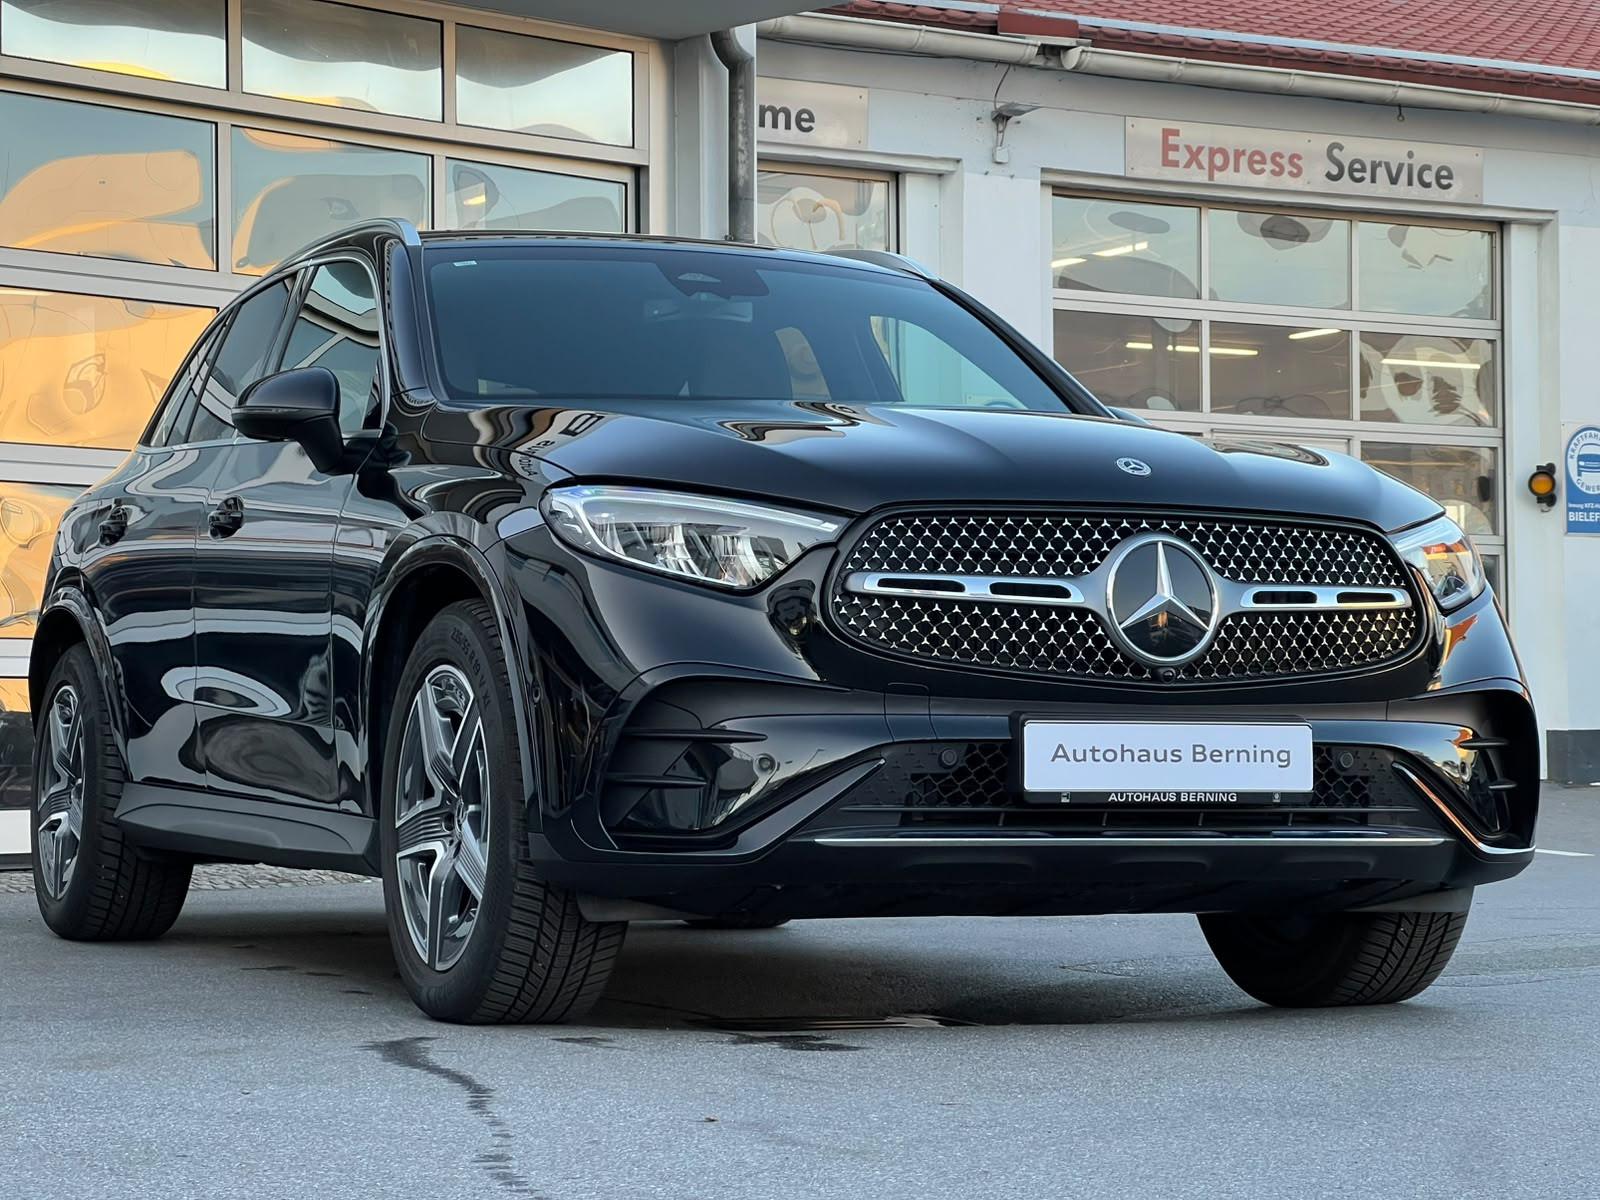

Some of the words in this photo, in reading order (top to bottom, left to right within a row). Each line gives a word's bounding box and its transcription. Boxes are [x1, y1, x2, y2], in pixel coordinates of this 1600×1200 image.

[758, 103, 816, 133] me
[1161, 127, 1304, 182] Express
[1324, 141, 1455, 190] Service
[1568, 432, 1600, 460] KRAFTFAH
[1050, 743, 1183, 763] Autohaus
[1191, 743, 1292, 768] Berning
[1108, 792, 1177, 802] AUTOHAUS
[1180, 792, 1237, 802] BERNING
